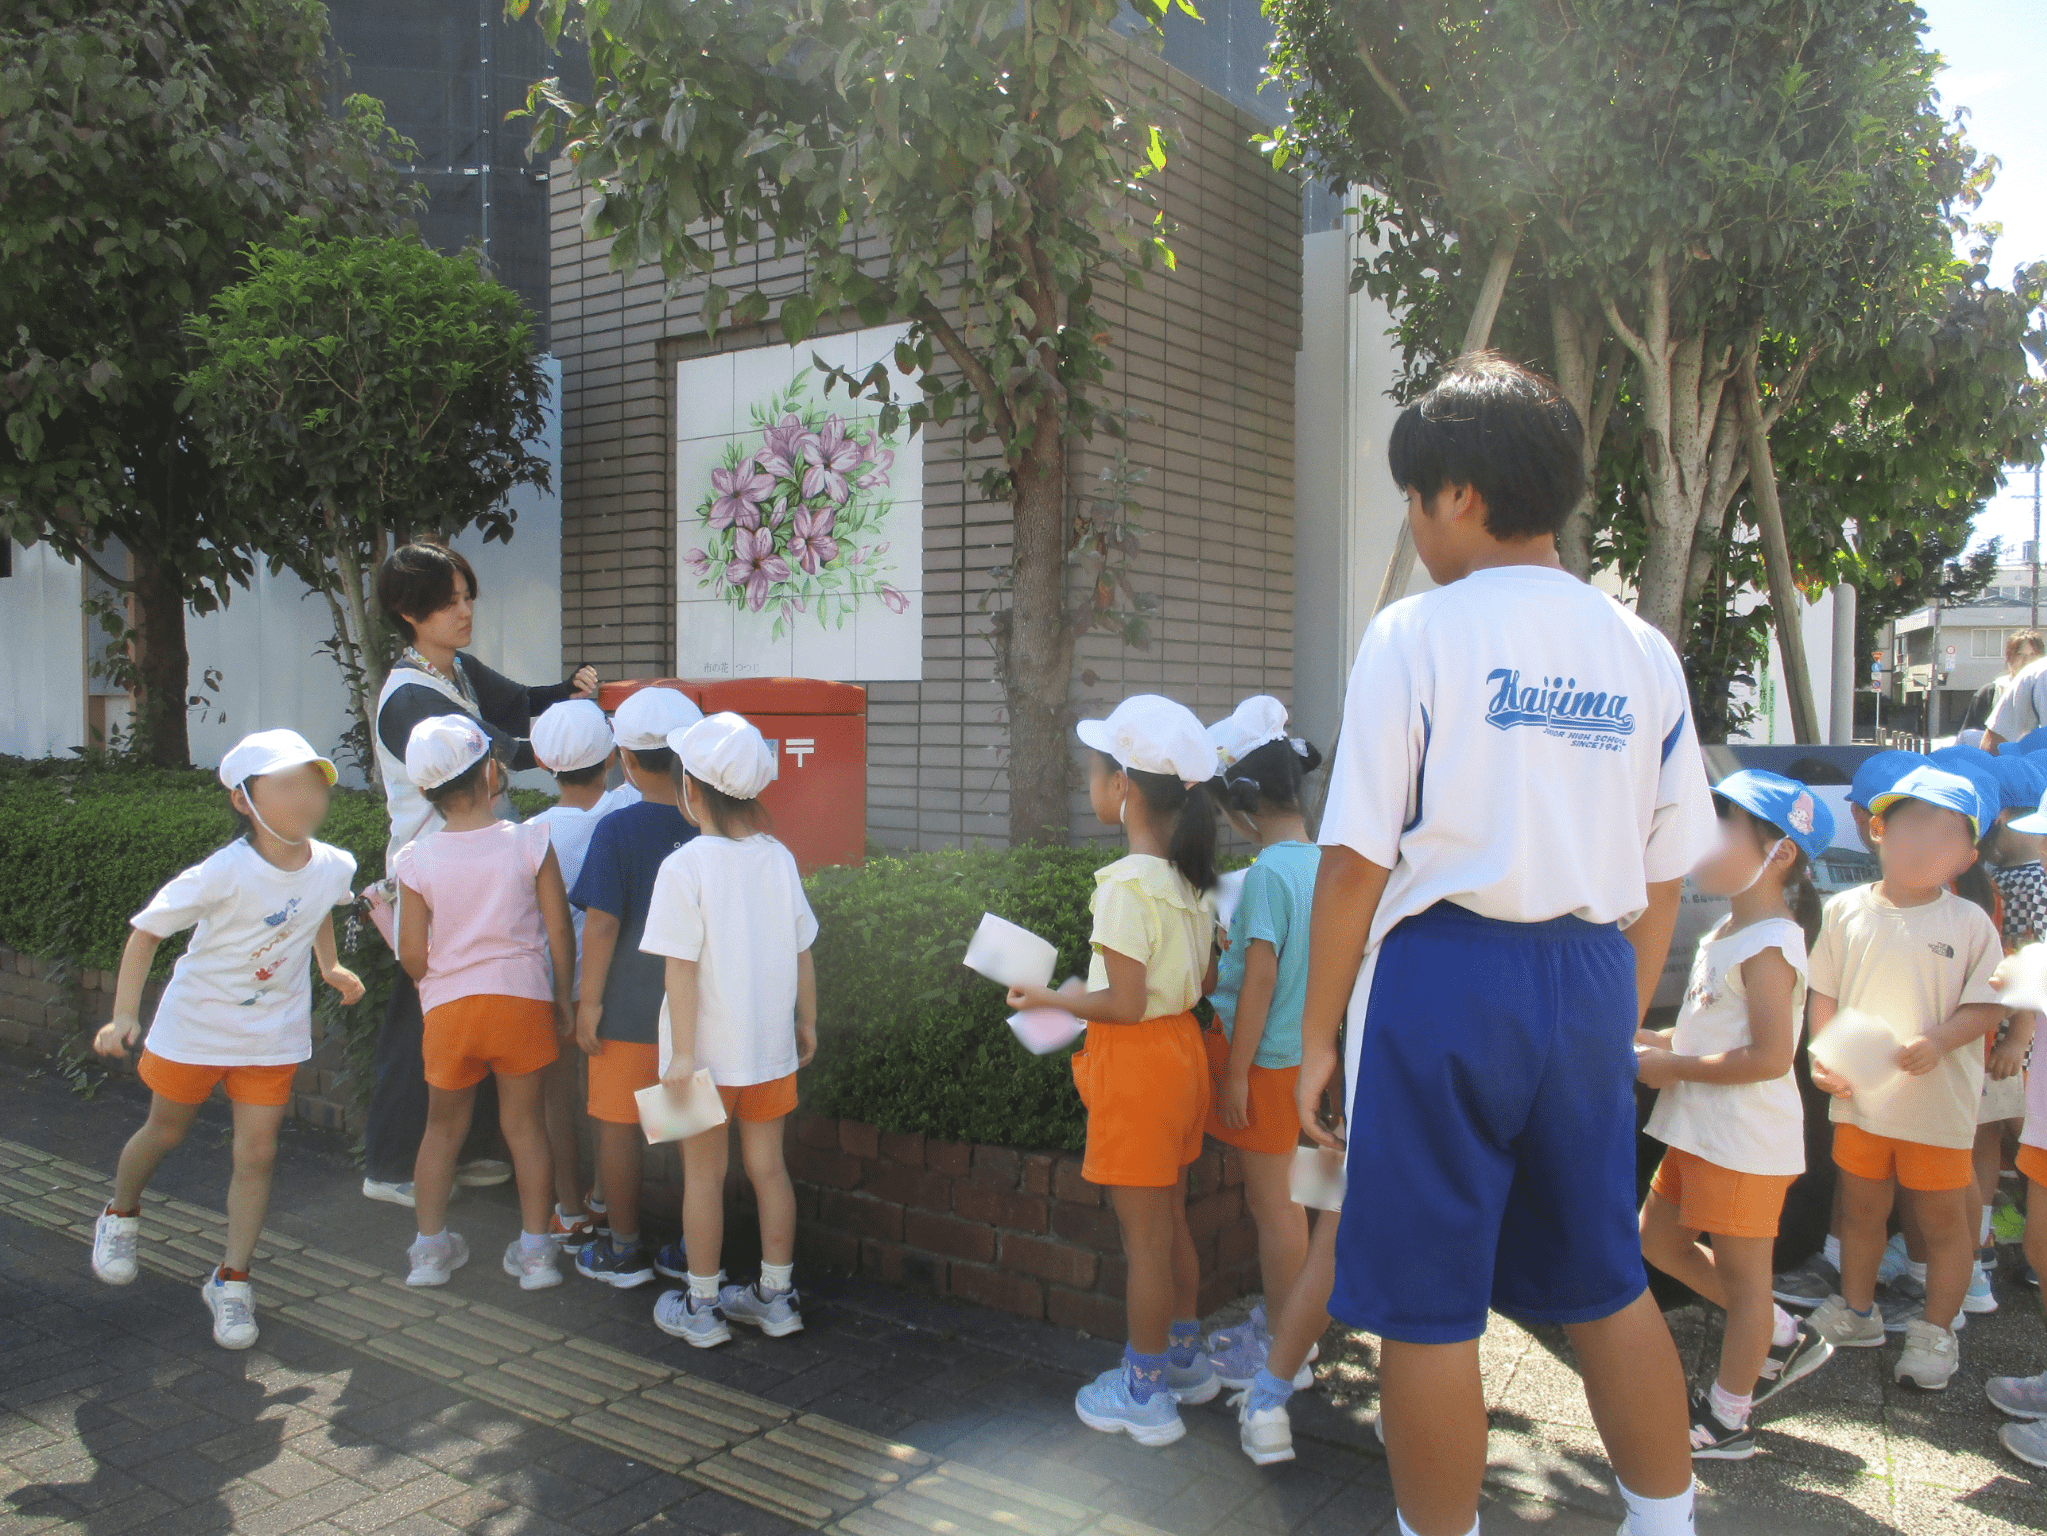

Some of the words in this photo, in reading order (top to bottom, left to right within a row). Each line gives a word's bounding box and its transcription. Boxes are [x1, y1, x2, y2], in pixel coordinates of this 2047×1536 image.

[703, 662, 729, 674] 市の花
[735, 663, 760, 674] つつじ
[1485, 668, 1629, 728] Kaijima
[1567, 732, 1592, 741] HIGH
[1570, 740, 1599, 749] SINCE
